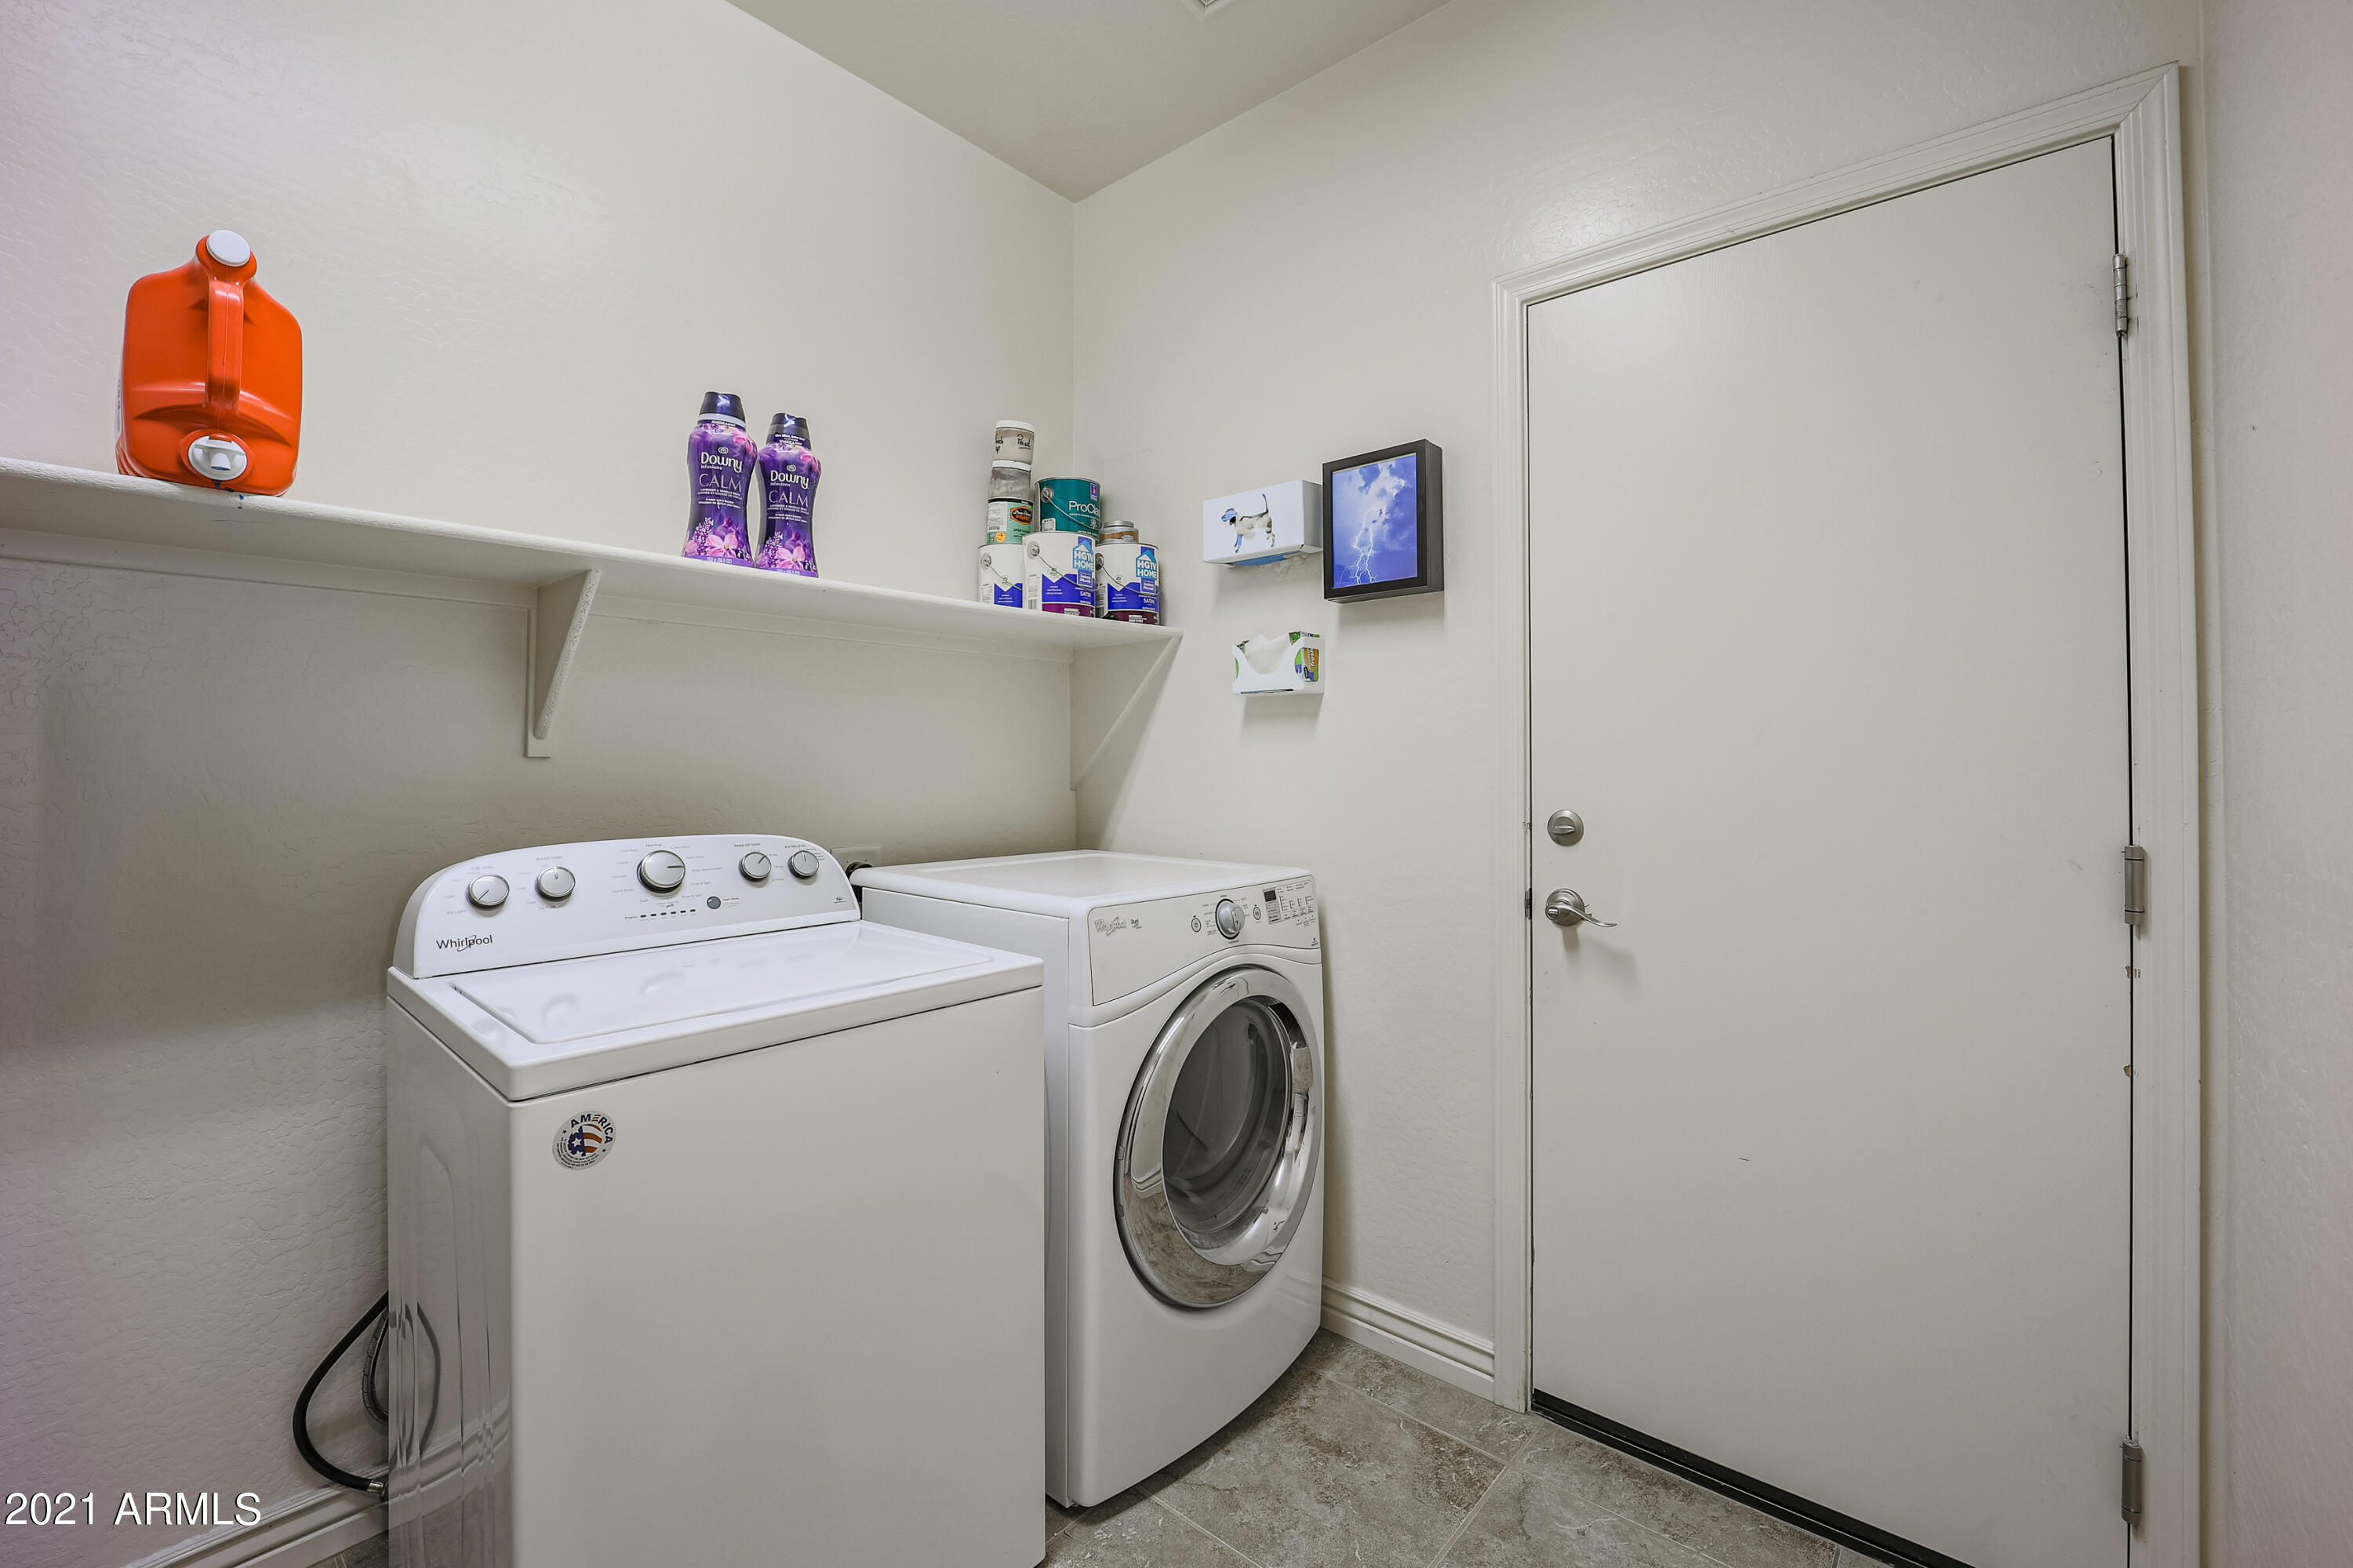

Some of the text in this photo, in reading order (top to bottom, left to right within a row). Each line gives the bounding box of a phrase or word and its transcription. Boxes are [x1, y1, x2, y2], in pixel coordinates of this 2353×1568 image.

[700, 452, 743, 474] Downy
[699, 473, 742, 493] CALM
[770, 470, 809, 489] Downy
[769, 490, 809, 508] CALM
[1068, 500, 1100, 517] ProCla
[1074, 551, 1094, 562] HGTV
[1136, 559, 1157, 571] HGTV
[1074, 559, 1095, 572] HOME
[1136, 568, 1158, 580] HOME
[436, 934, 493, 951] Whirlpool
[571, 1114, 613, 1144] AMERICA
